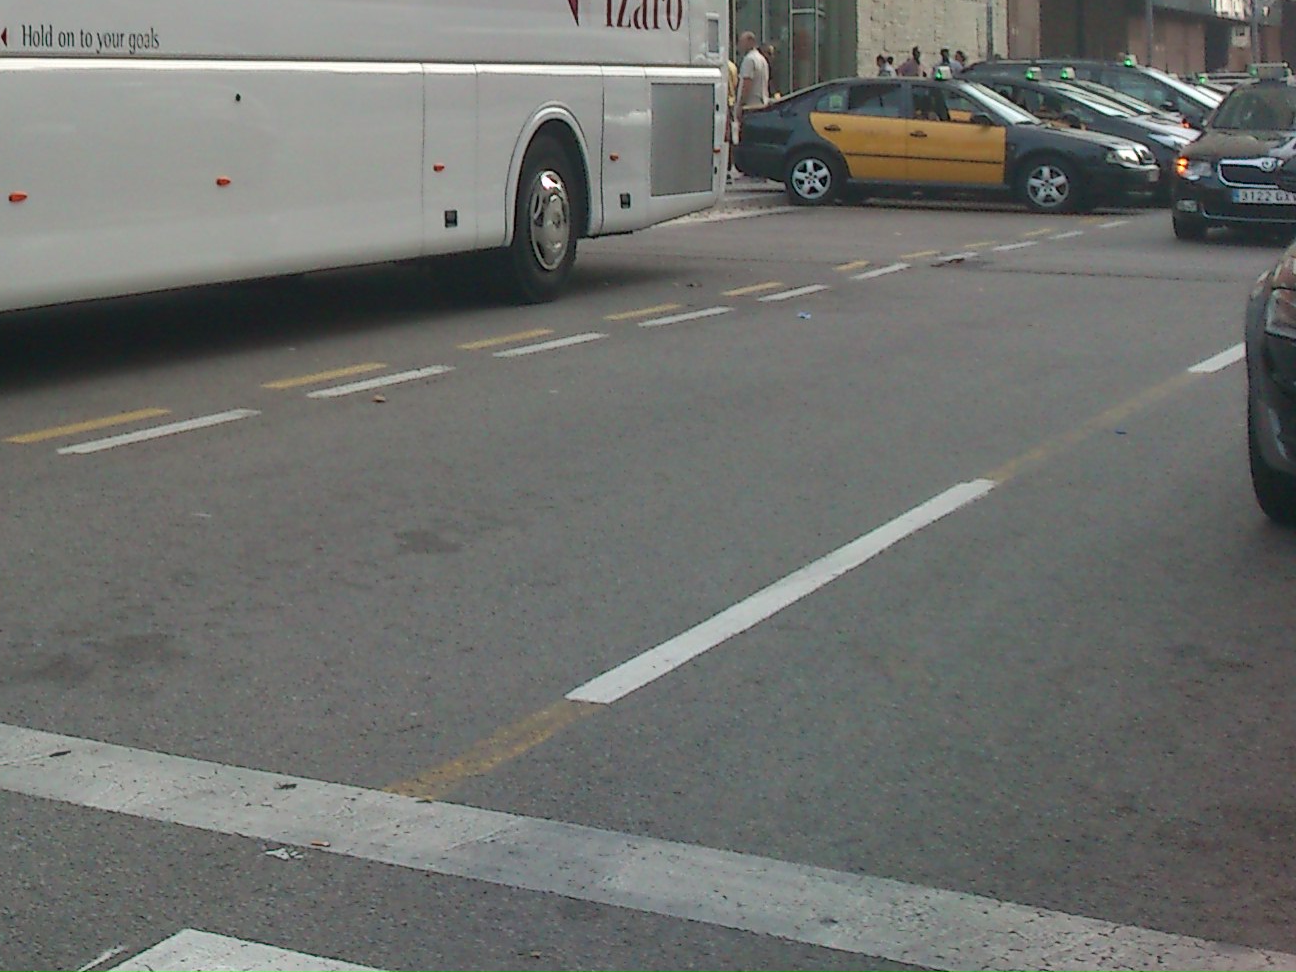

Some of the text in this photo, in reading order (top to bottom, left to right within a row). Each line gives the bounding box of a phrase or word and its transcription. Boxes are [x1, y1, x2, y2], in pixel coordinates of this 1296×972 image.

[21, 24, 160, 55] Hold on to your goals
